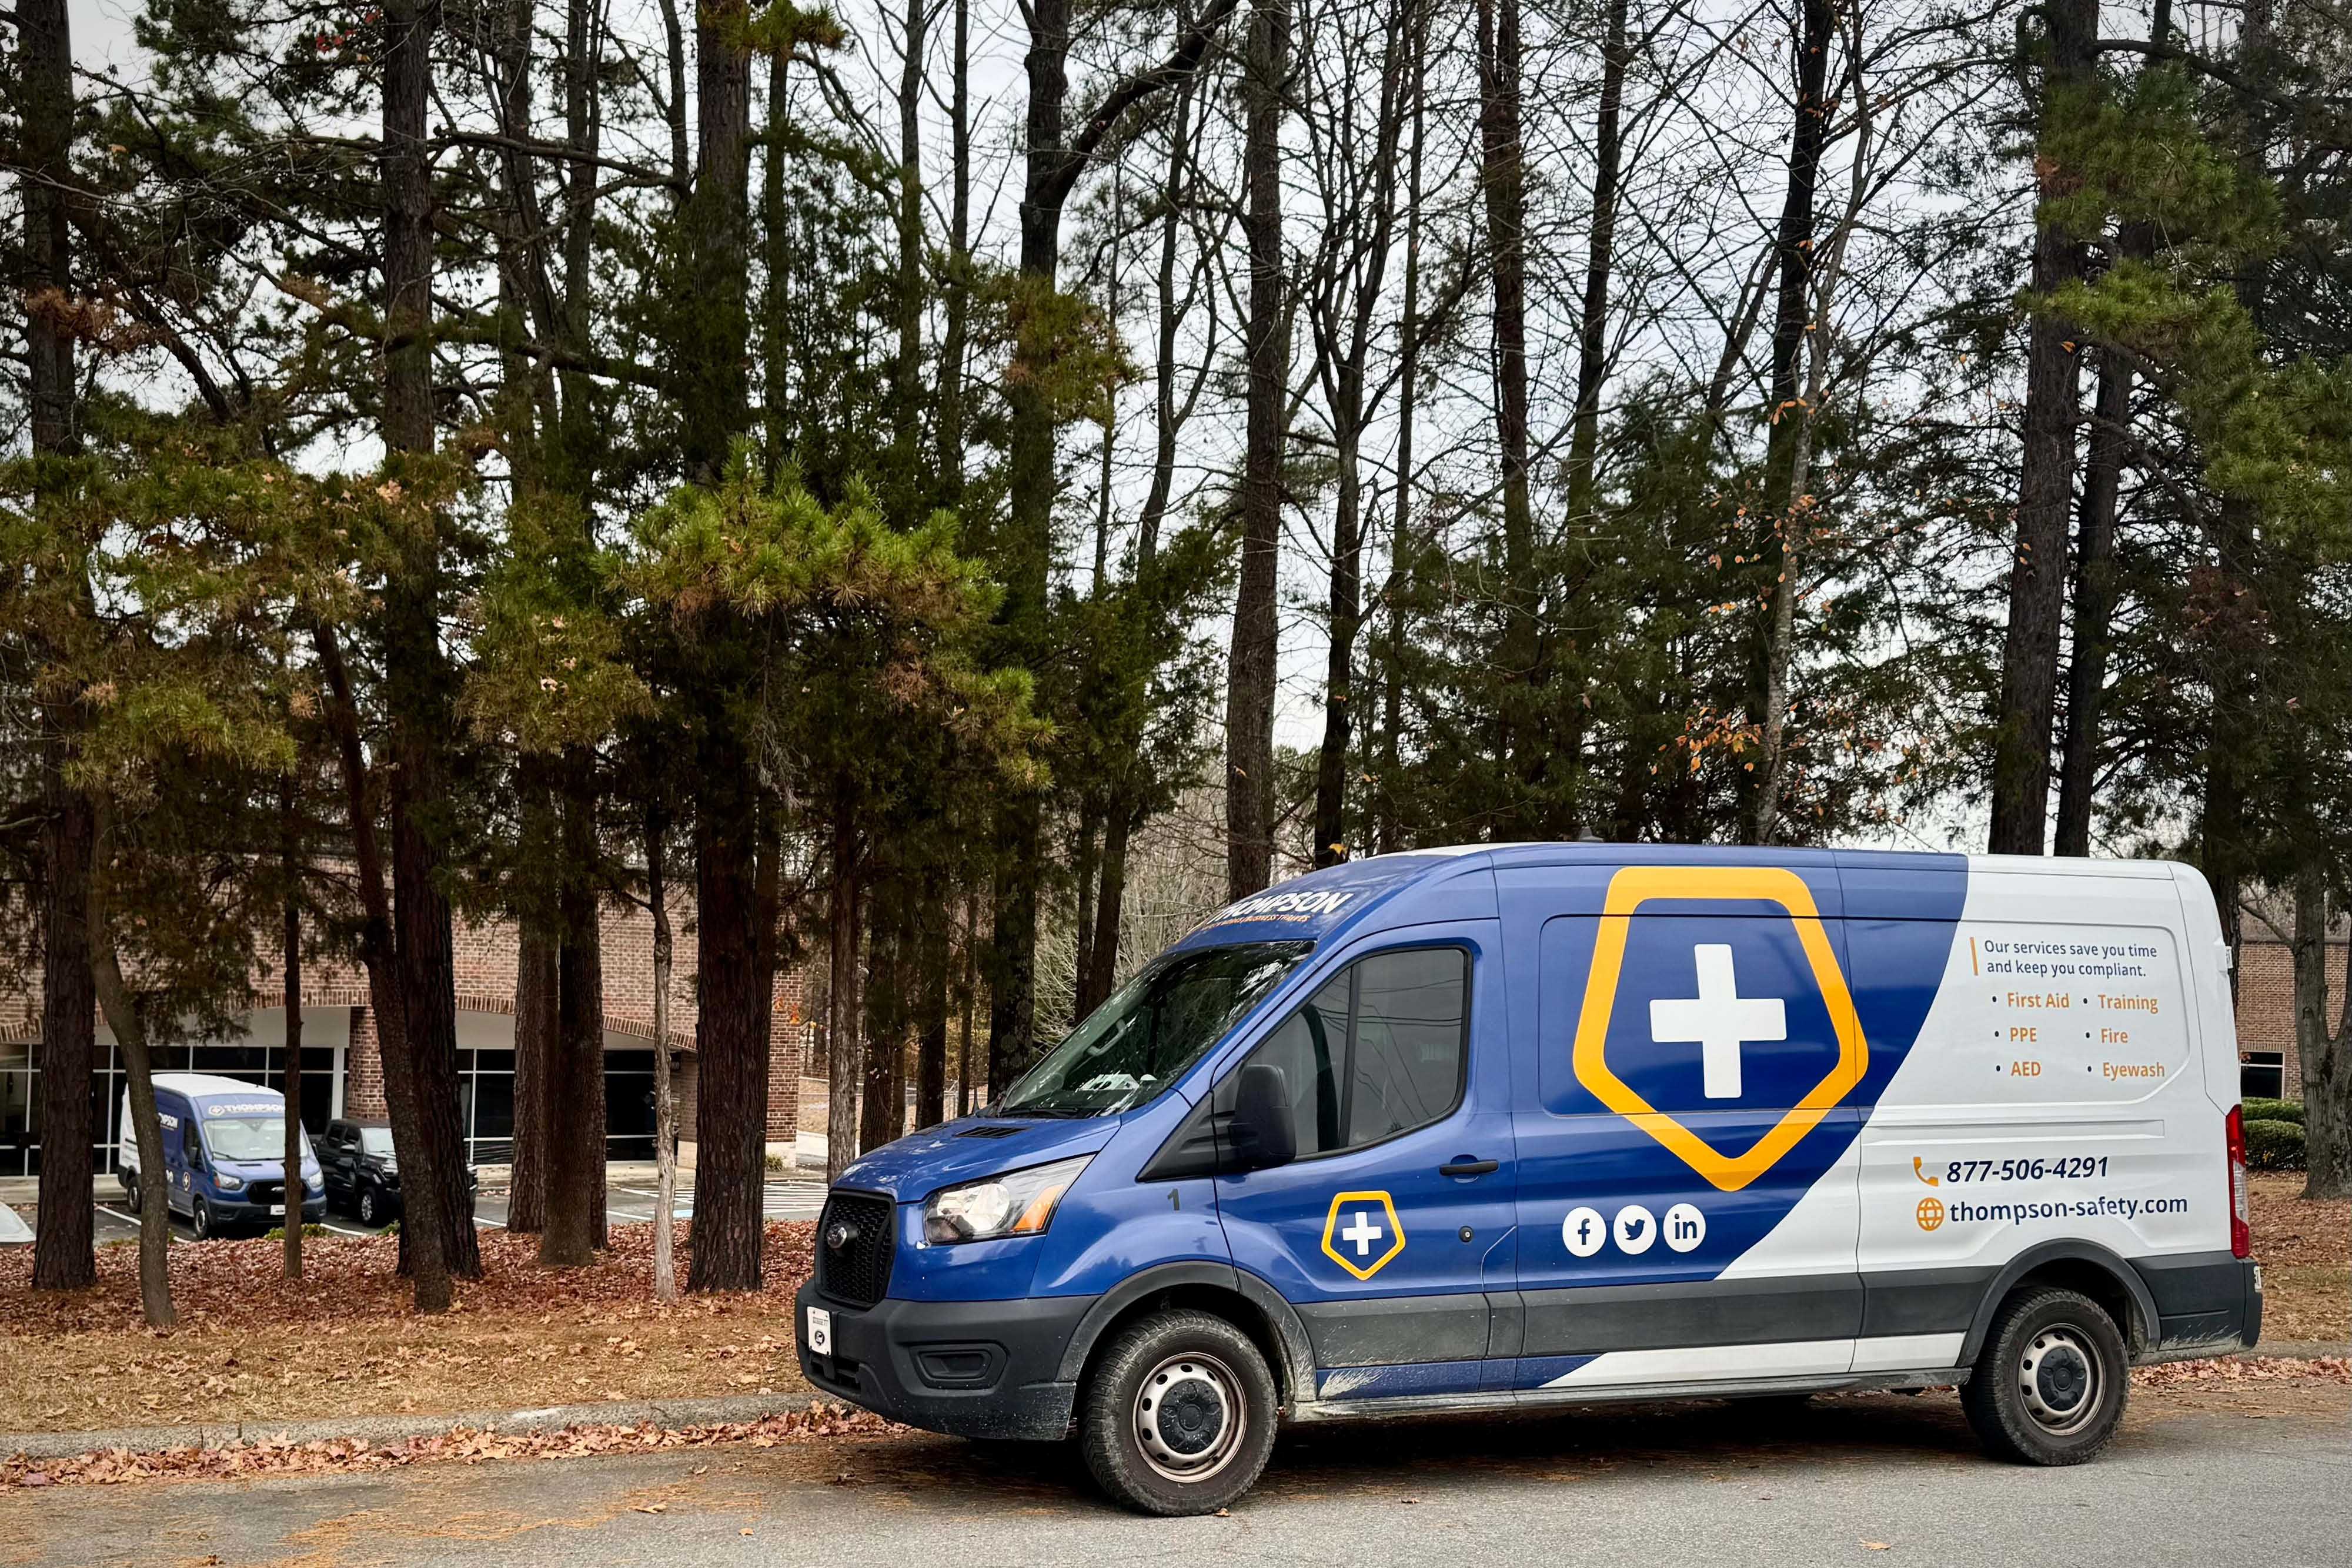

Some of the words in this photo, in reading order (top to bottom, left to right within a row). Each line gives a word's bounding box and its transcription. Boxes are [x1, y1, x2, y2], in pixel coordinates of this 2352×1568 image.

[1984, 940, 2009, 954] Our
[2013, 941, 2066, 955] services
[2070, 945, 2099, 956] save
[2102, 946, 2125, 960] you
[2128, 943, 2157, 958] time
[1987, 959, 2012, 973] and
[2016, 959, 2047, 978] keep
[2051, 964, 2075, 978] you
[2079, 962, 2146, 979] compliant.
[2007, 992, 2042, 1008] First
[2046, 992, 2070, 1008] Aid
[2097, 994, 2159, 1015] Training
[2010, 1027, 2037, 1042] PPE
[2101, 1028, 2128, 1044] Fire
[2011, 1061, 2041, 1076] AED
[2103, 1062, 2165, 1081] Eyewash
[1946, 1156, 2109, 1183] 877-506-4291
[1167, 1188, 1180, 1211] 1
[1949, 1196, 2188, 1225] thompson-safety.com
[1674, 1213, 1698, 1239] in
